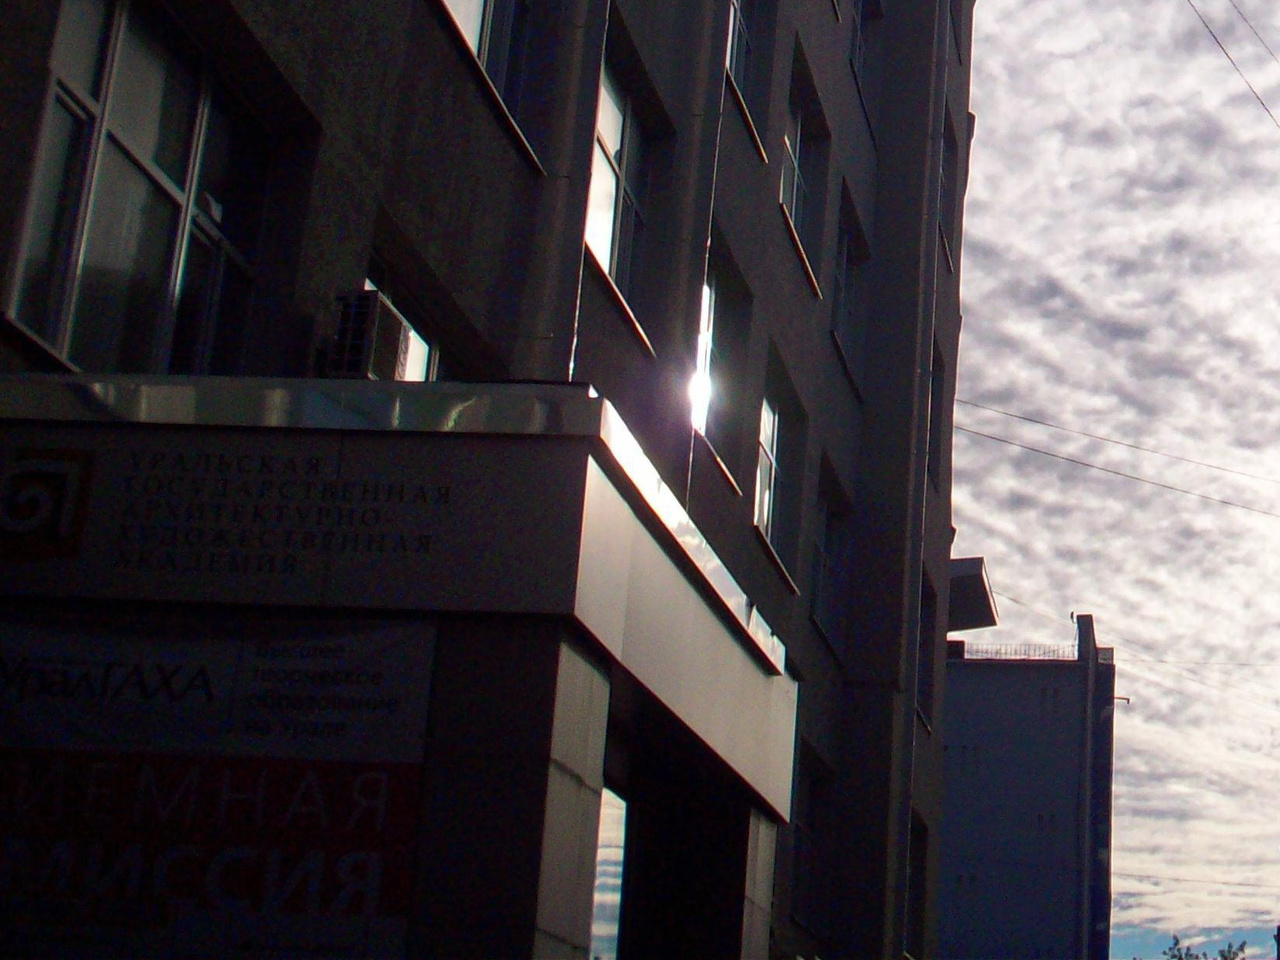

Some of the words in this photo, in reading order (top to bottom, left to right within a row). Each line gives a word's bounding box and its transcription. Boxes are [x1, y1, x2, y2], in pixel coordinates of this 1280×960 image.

[129, 449, 323, 476] УРАЛЬСКАЯ
[123, 475, 451, 505] ГОСУДАРСТВЕННАЯ
[116, 523, 433, 554] ХУДОЖЕСТВЕННАЯ
[113, 547, 299, 576] АКАДЕМИЯ
